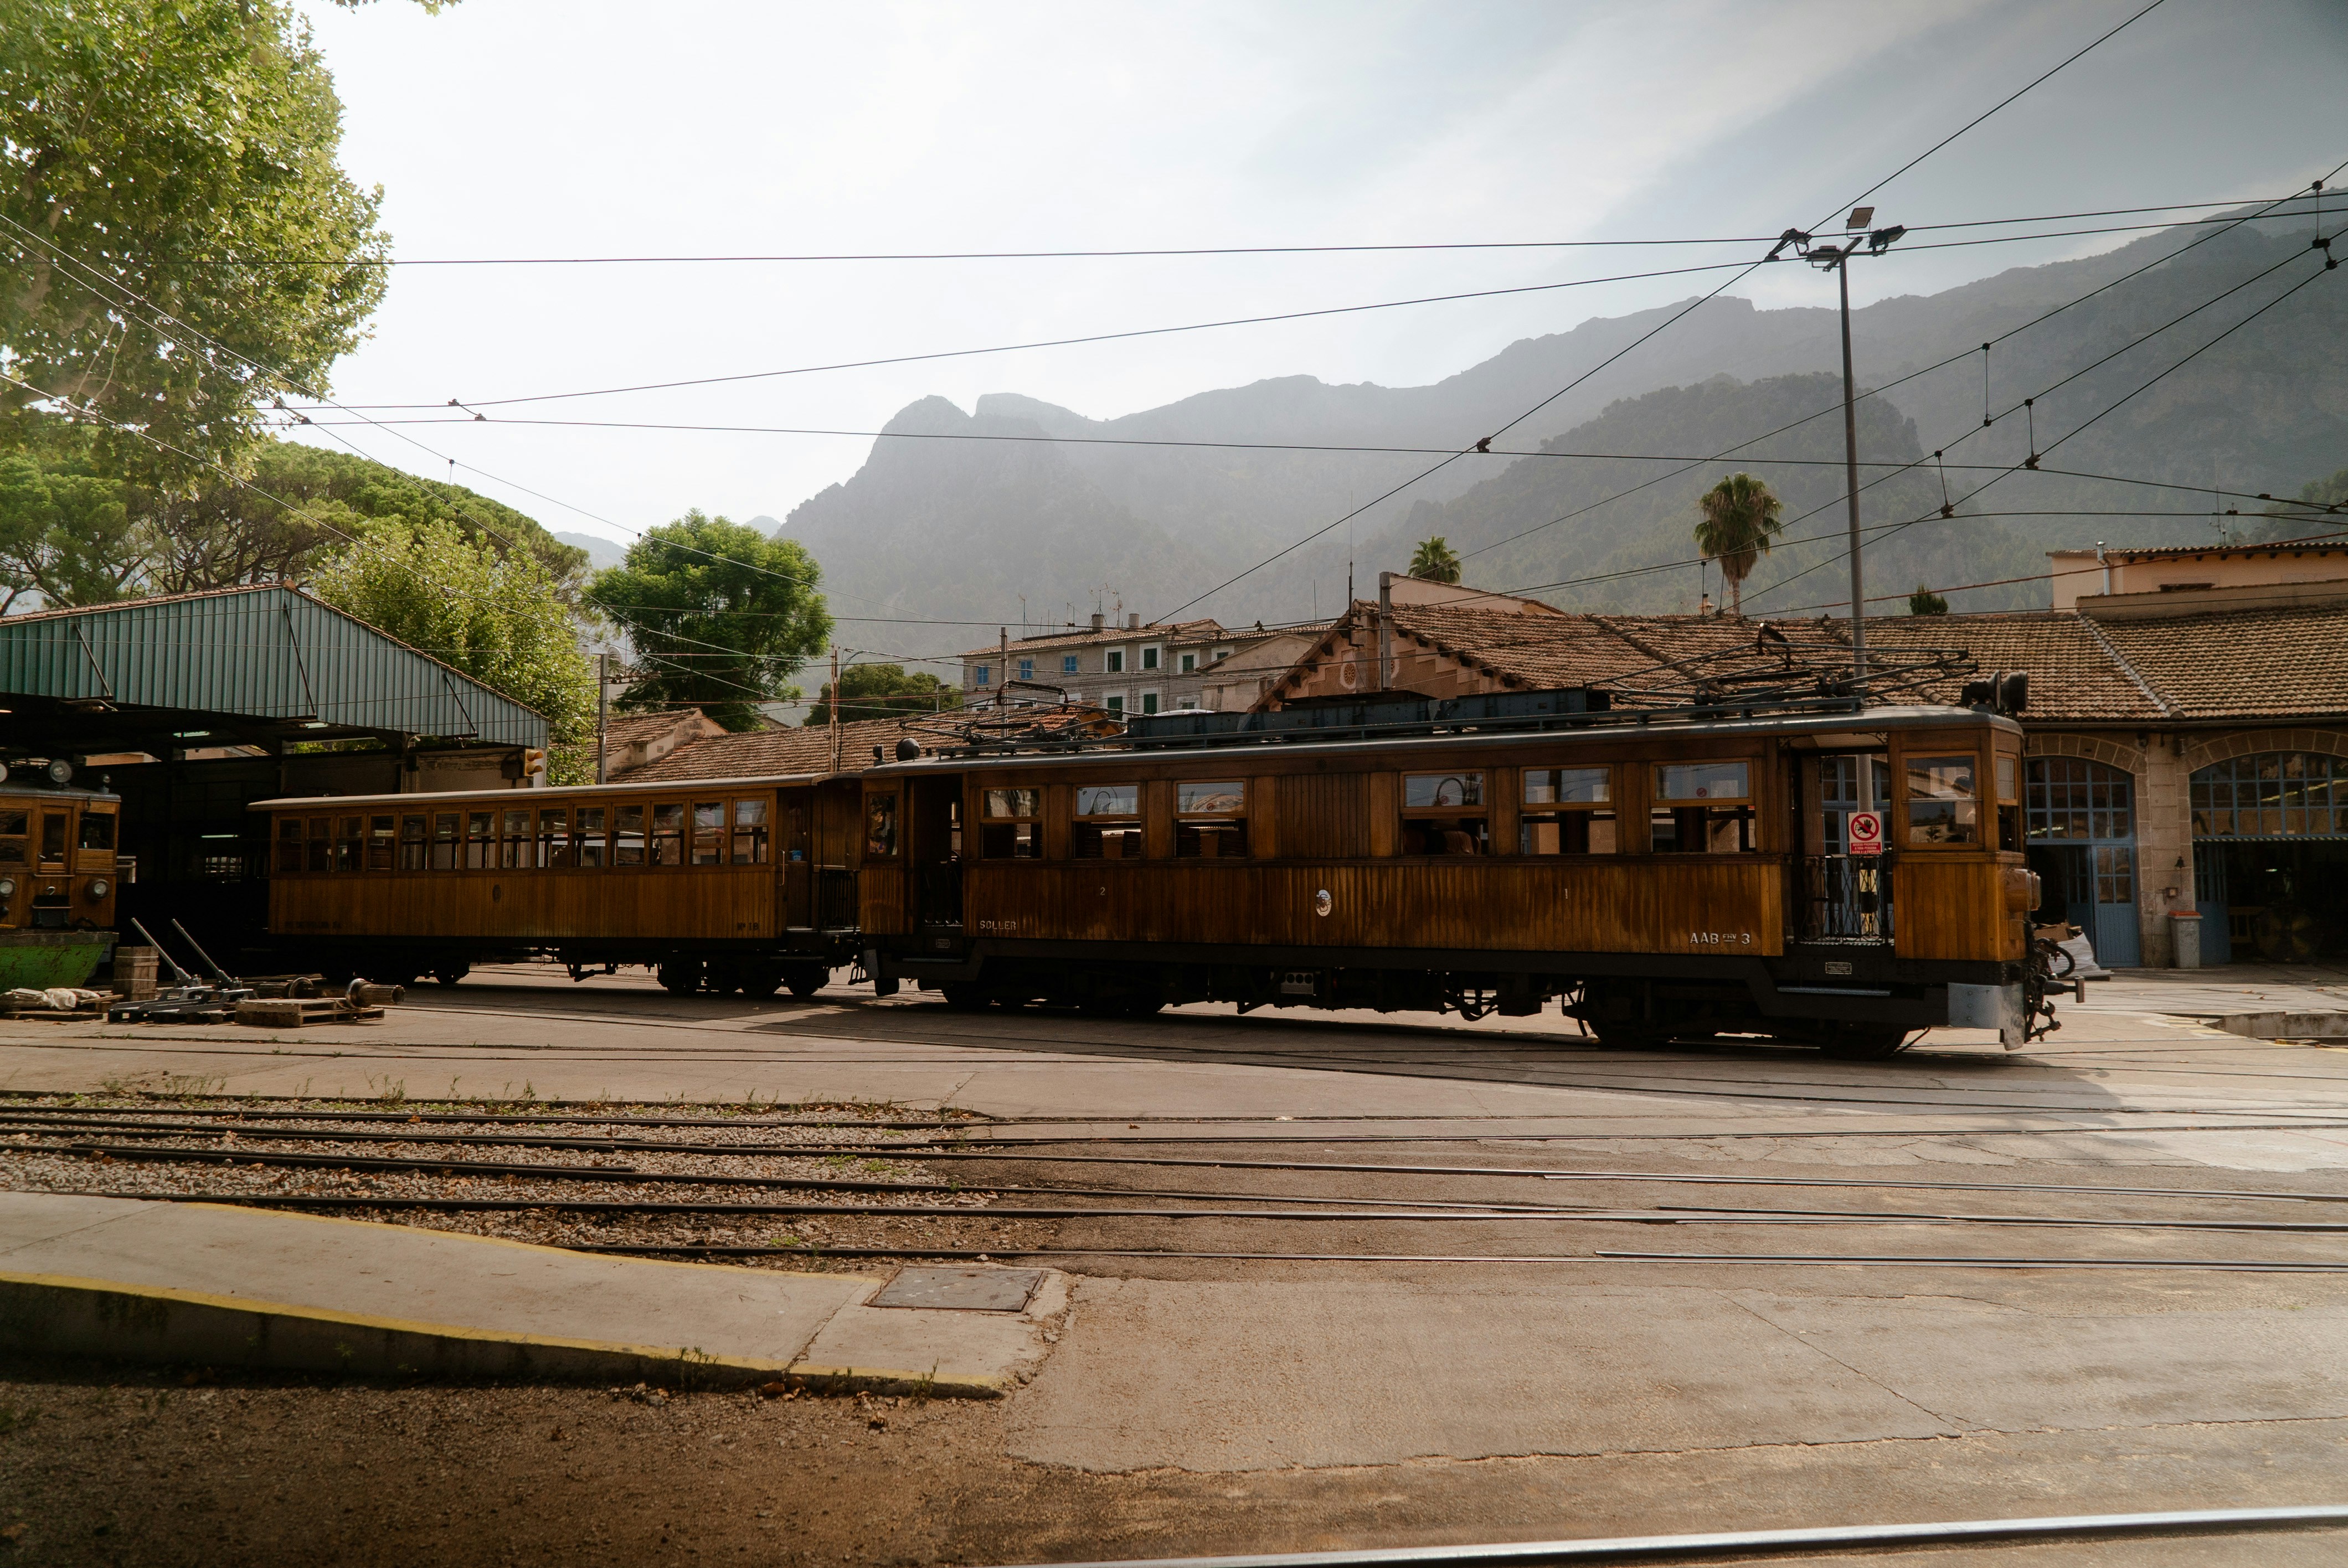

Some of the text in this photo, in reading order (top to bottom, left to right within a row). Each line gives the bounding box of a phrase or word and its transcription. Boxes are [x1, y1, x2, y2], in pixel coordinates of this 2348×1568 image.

[1099, 886, 1105, 896] 2
[1564, 888, 1568, 899] 1
[980, 920, 1016, 930] SOLLER
[1690, 932, 1750, 945] AAB FHV 3
